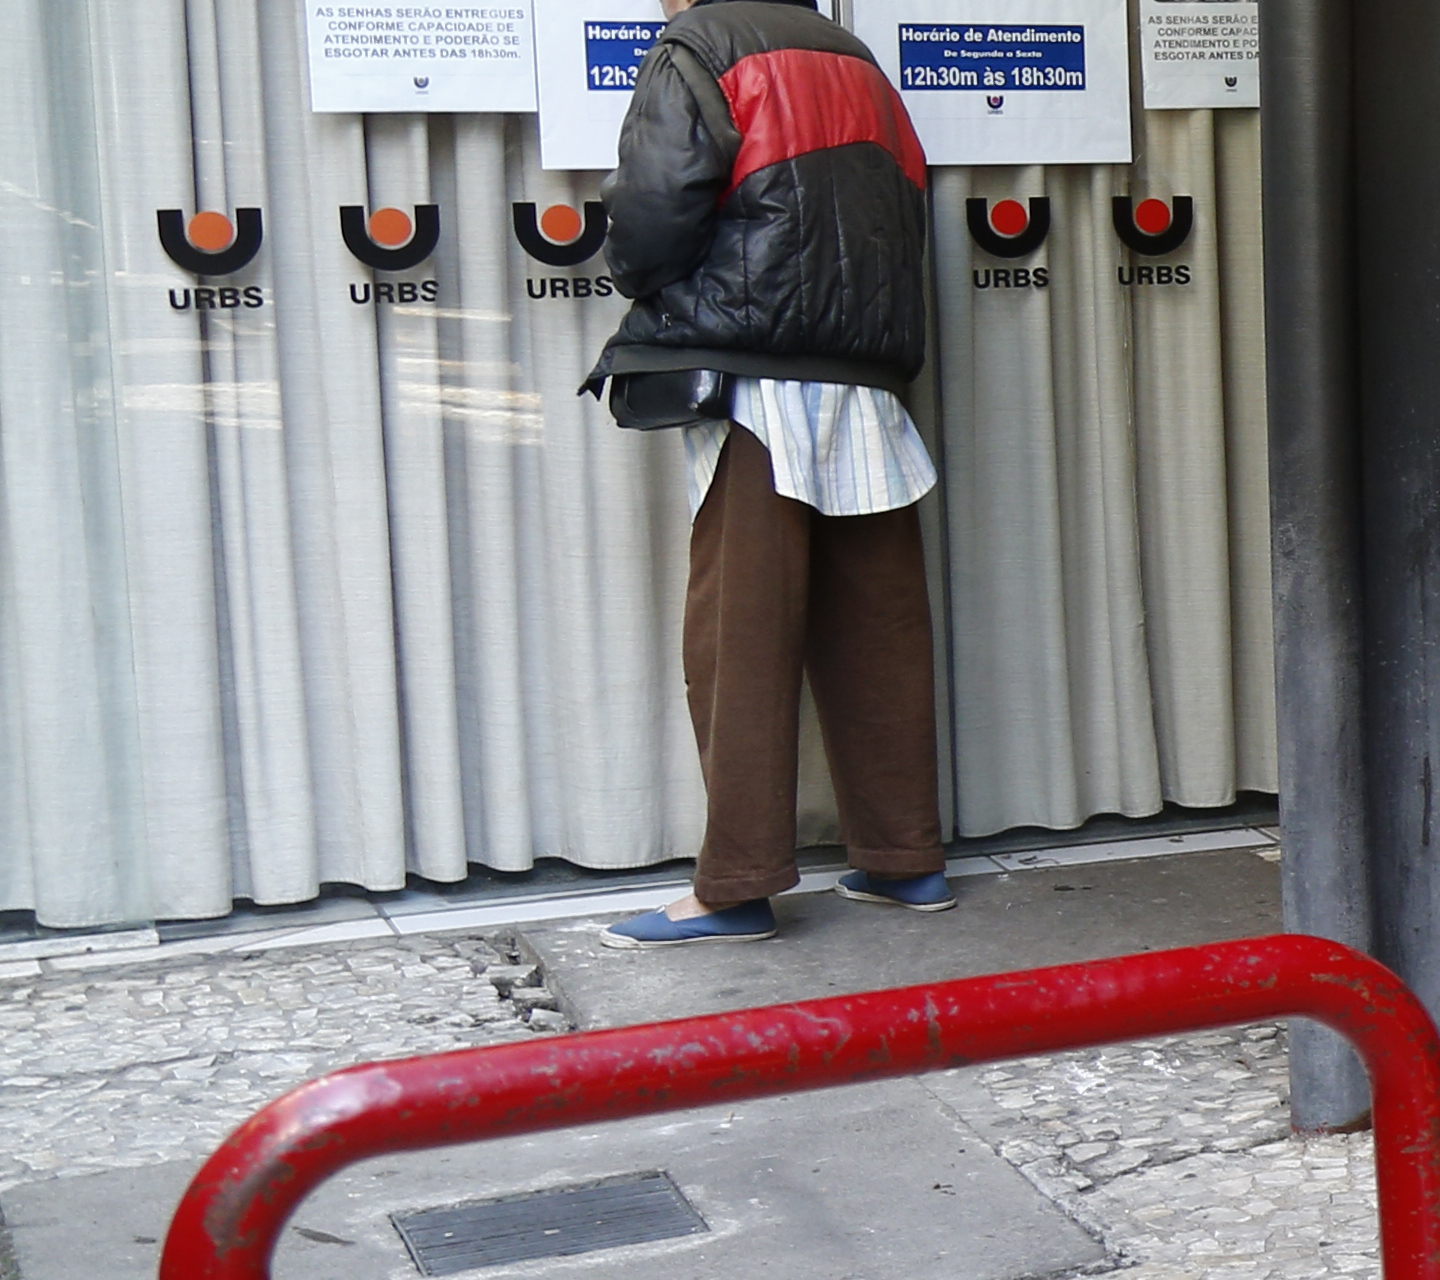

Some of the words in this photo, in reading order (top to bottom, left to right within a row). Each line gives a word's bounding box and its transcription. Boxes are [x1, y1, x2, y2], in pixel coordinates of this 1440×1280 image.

[316, 7, 334, 17] AS
[338, 8, 392, 18] SENHAS
[396, 7, 442, 18] SERÃO
[446, 8, 524, 19] ENTREGUES
[1148, 16, 1162, 24] AS
[1166, 16, 1209, 24] SENHAS
[1212, 14, 1248, 24] SERÃO
[328, 22, 404, 31] CONFORME
[408, 22, 493, 32] CAPACIDADE
[497, 22, 514, 32] DE
[588, 25, 651, 39] Horário
[1158, 28, 1218, 36] CONFORME
[1221, 28, 1258, 36] CAPAC
[324, 35, 419, 44] ATENDIMENTO
[423, 35, 431, 44] E
[435, 35, 499, 45] PODERÃO
[503, 36, 520, 45] SE
[902, 28, 960, 42] Horário
[964, 28, 982, 42] de
[987, 29, 1081, 42] Atendimento
[1154, 40, 1230, 48] ATENDIMENTO
[1233, 40, 1239, 48] E
[325, 48, 389, 58] ESGOTAR
[393, 49, 436, 58] ANTES
[440, 49, 467, 58] DAS
[961, 51, 1004, 59] Segunda
[1154, 52, 1205, 60] ESGOTAR
[1209, 52, 1243, 60] ANTES
[590, 66, 638, 86] 12h3
[903, 67, 978, 86] 12h30m
[984, 67, 1006, 86] às
[1011, 67, 1082, 86] 18h30m
[973, 267, 1049, 288] URBS
[1118, 266, 1191, 285] URBS
[350, 280, 439, 304] URBS
[527, 276, 613, 299] URBS
[169, 287, 263, 310] URBS
